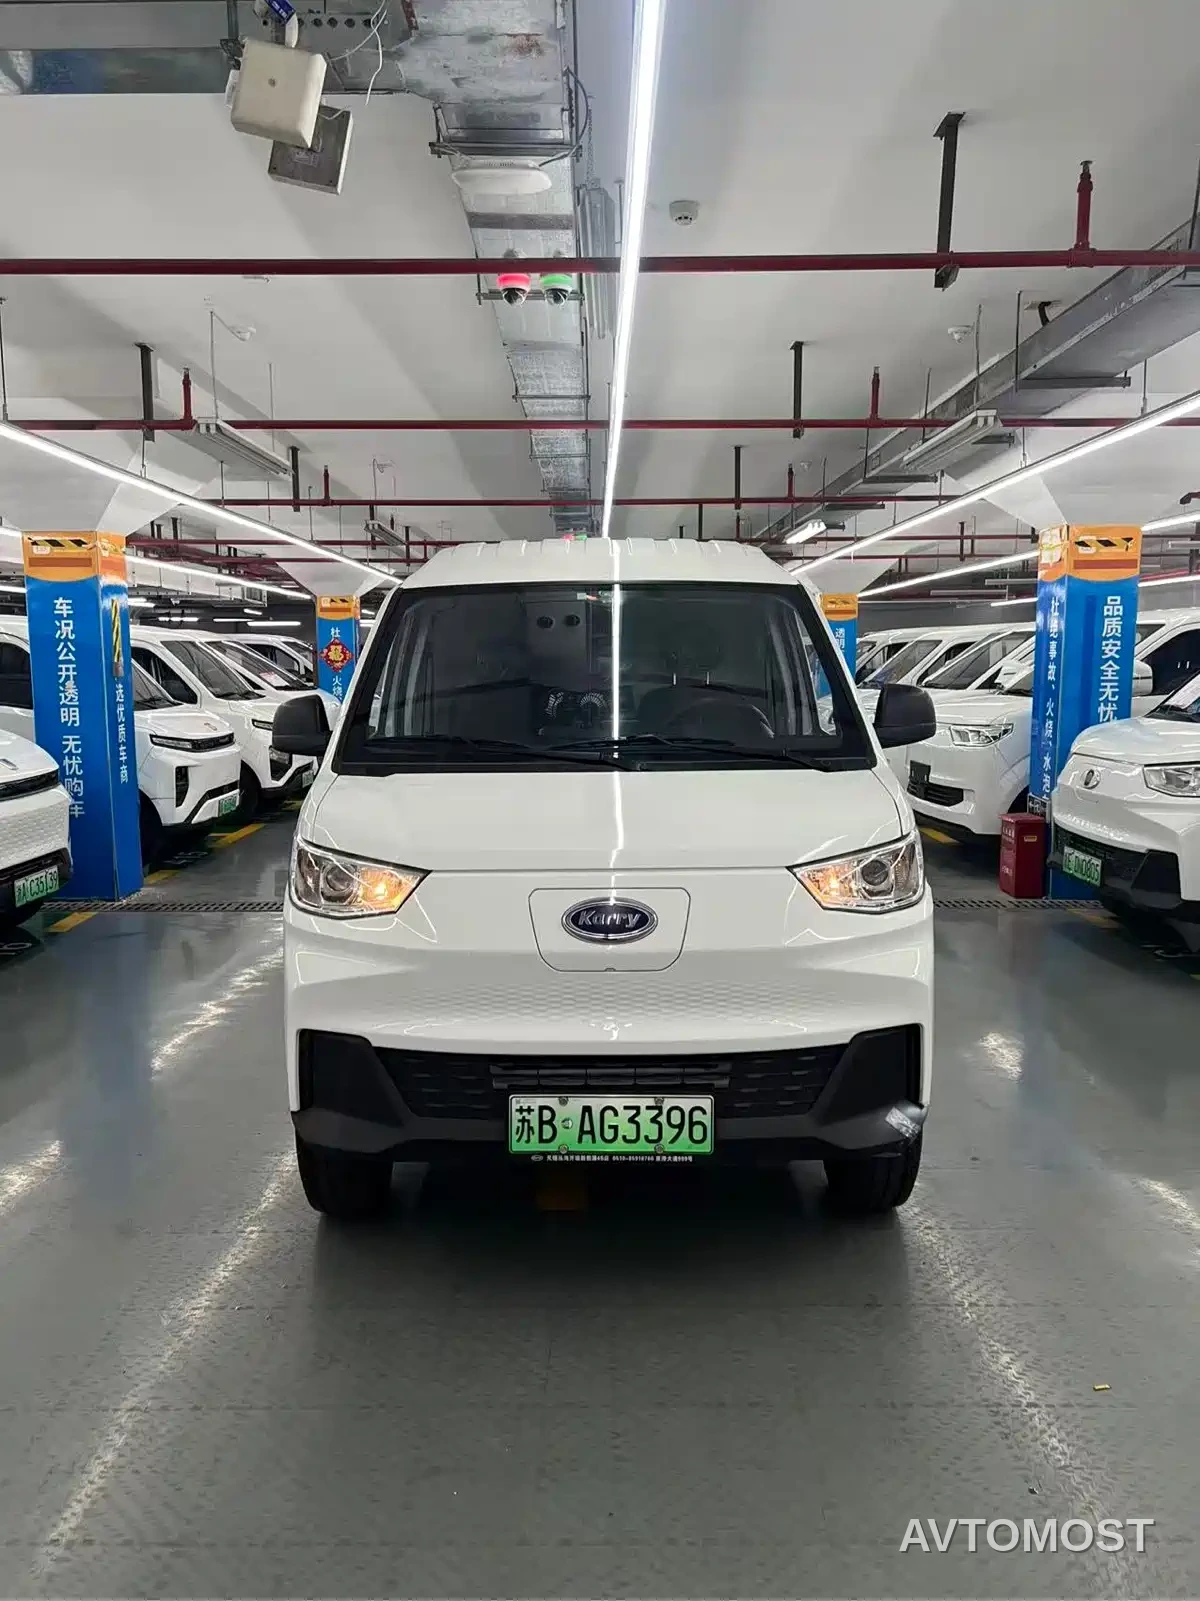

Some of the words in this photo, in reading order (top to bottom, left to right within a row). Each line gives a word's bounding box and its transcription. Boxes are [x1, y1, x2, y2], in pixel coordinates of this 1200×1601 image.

[53, 597, 80, 727] 车况公开透明
[1098, 596, 1123, 722] 品质安全无忧
[62, 735, 85, 818] 无忧购车
[115, 677, 129, 784] 选优质车商
[578, 910, 641, 928] Karry
